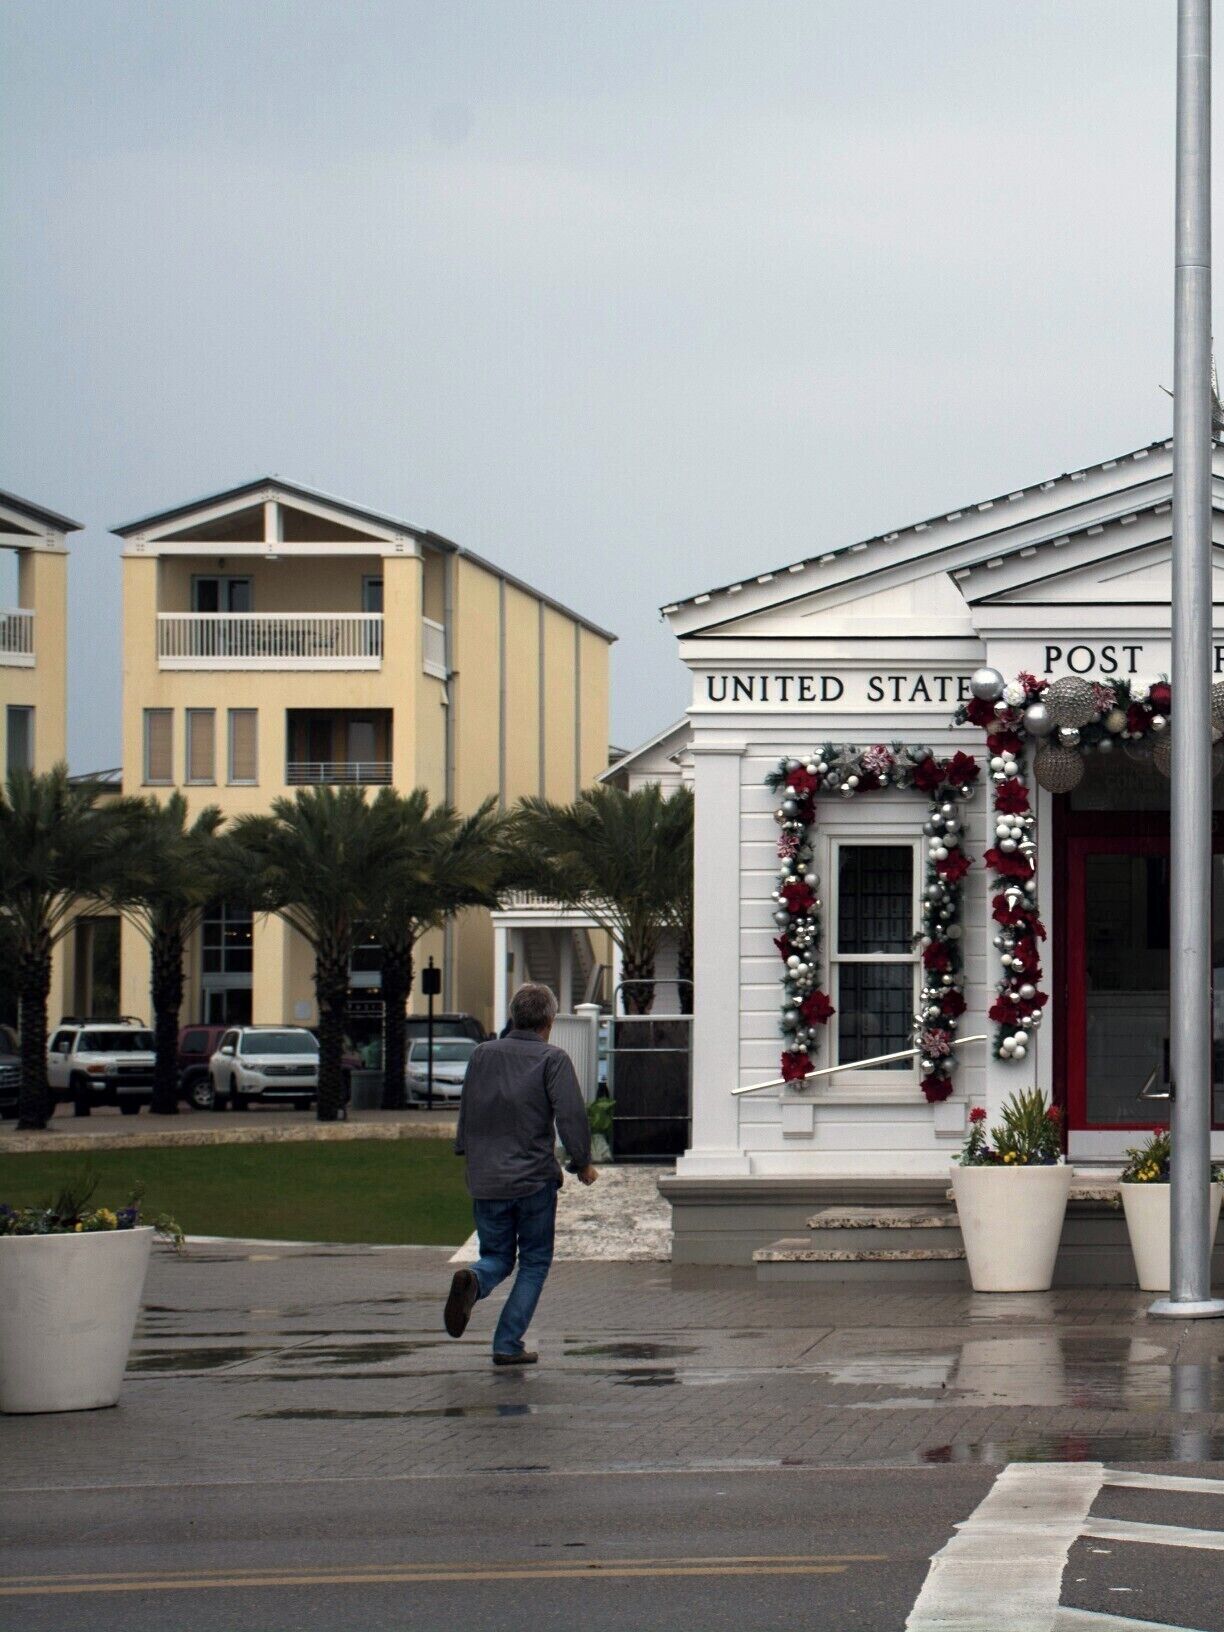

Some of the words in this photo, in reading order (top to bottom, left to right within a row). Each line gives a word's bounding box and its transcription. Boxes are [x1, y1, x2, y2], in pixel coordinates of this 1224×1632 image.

[1044, 645, 1143, 674] POST
[707, 676, 844, 702] UNITED
[867, 676, 974, 702] STATE
